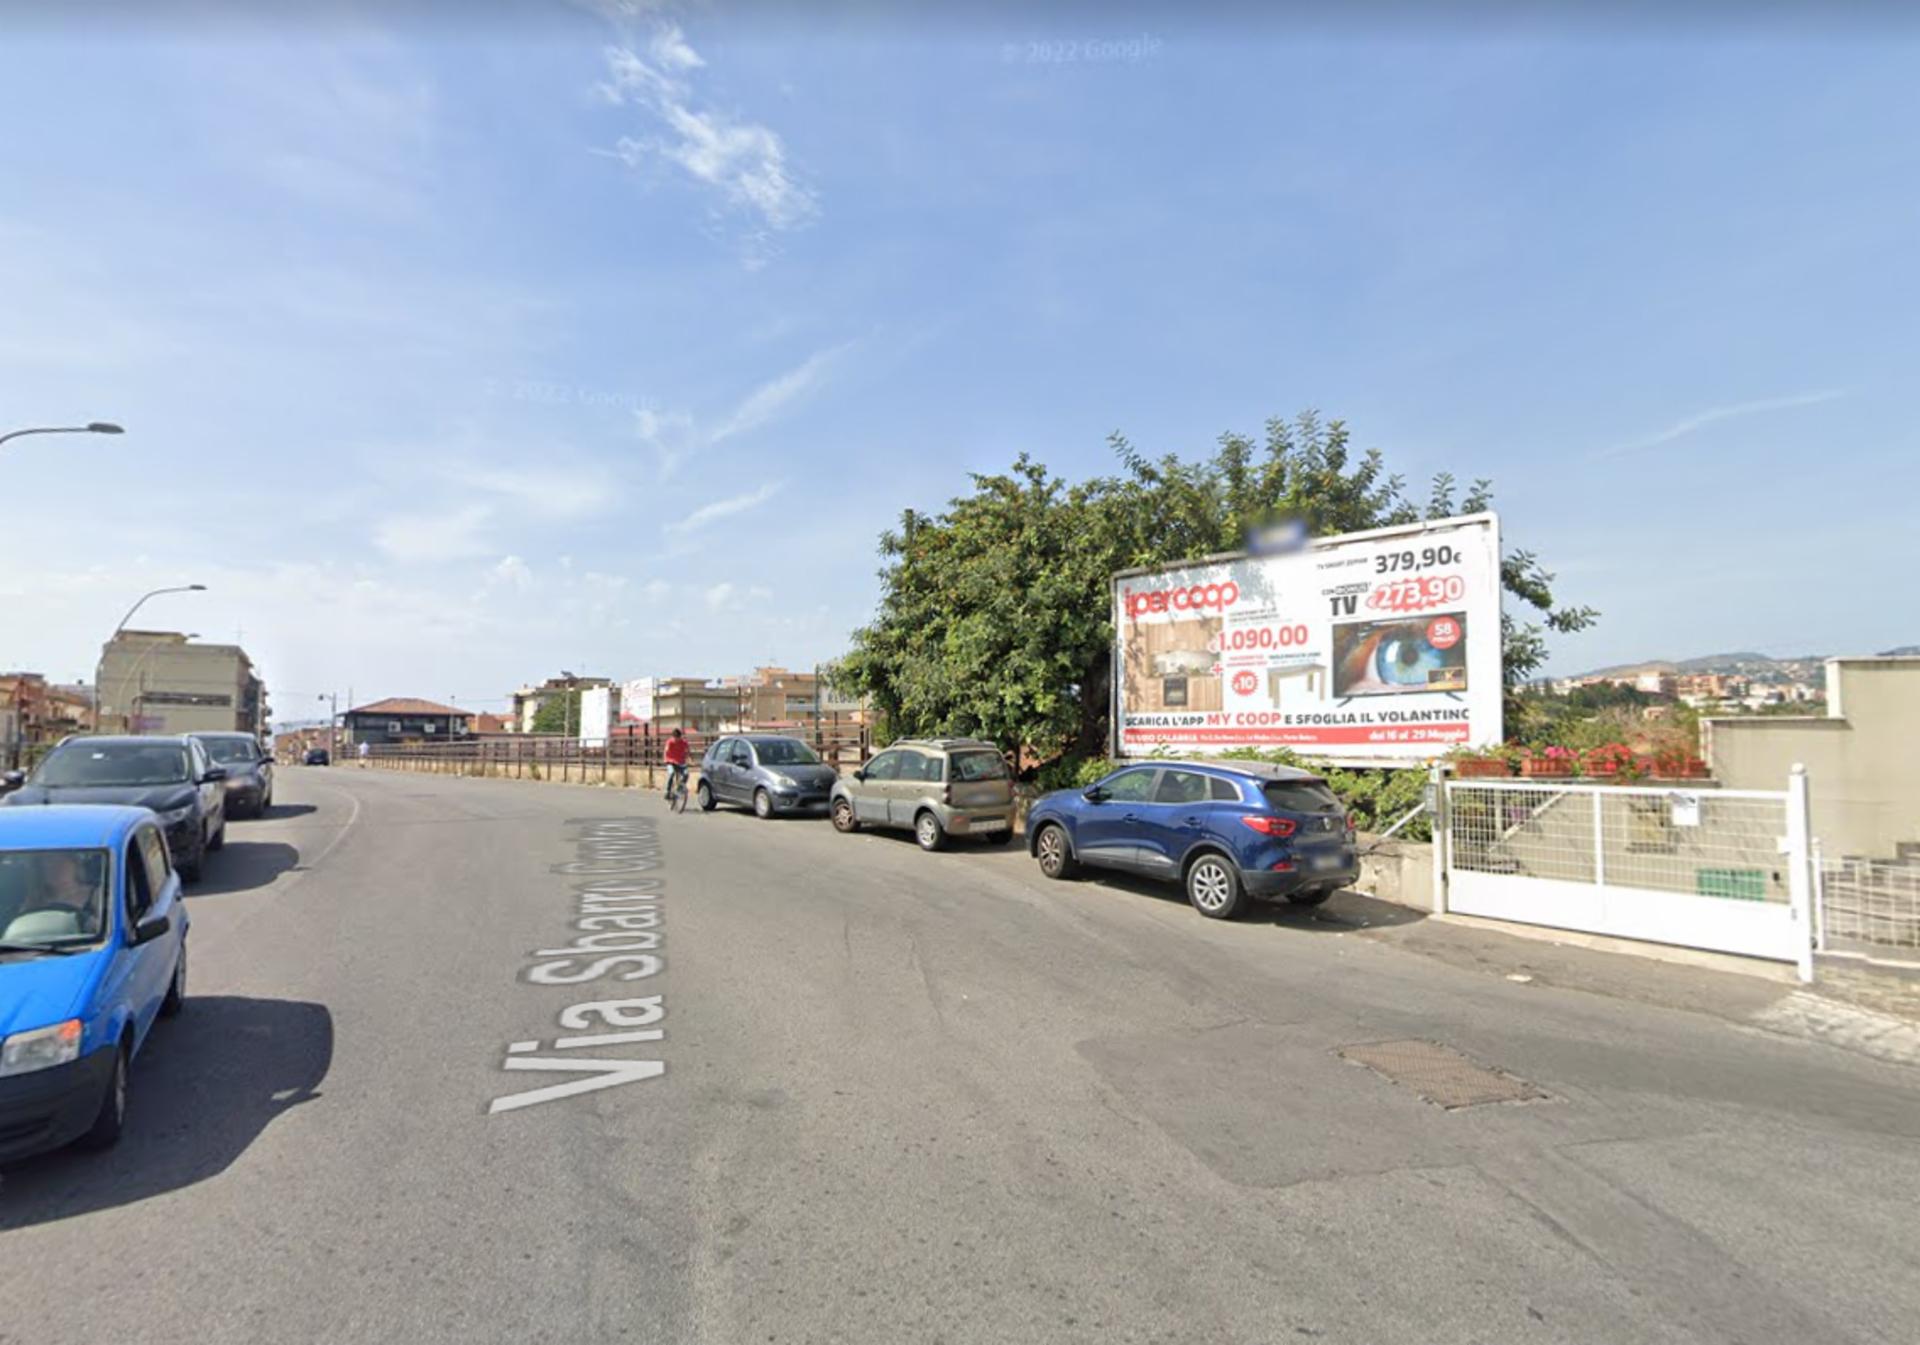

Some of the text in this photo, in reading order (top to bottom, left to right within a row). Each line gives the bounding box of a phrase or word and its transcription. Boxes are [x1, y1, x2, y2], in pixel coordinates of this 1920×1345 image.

[1123, 581, 1239, 620] ipercoop
[1330, 596, 1357, 616] TV
[1434, 623, 1453, 636] 58
[1125, 716, 1169, 726] SCARICA
[1172, 716, 1204, 726] L'APP
[1207, 713, 1231, 725] MY
[1236, 712, 1281, 725] COOP
[1285, 714, 1293, 725] E
[1296, 712, 1356, 725] SFOGLIA
[1361, 712, 1374, 723] IL
